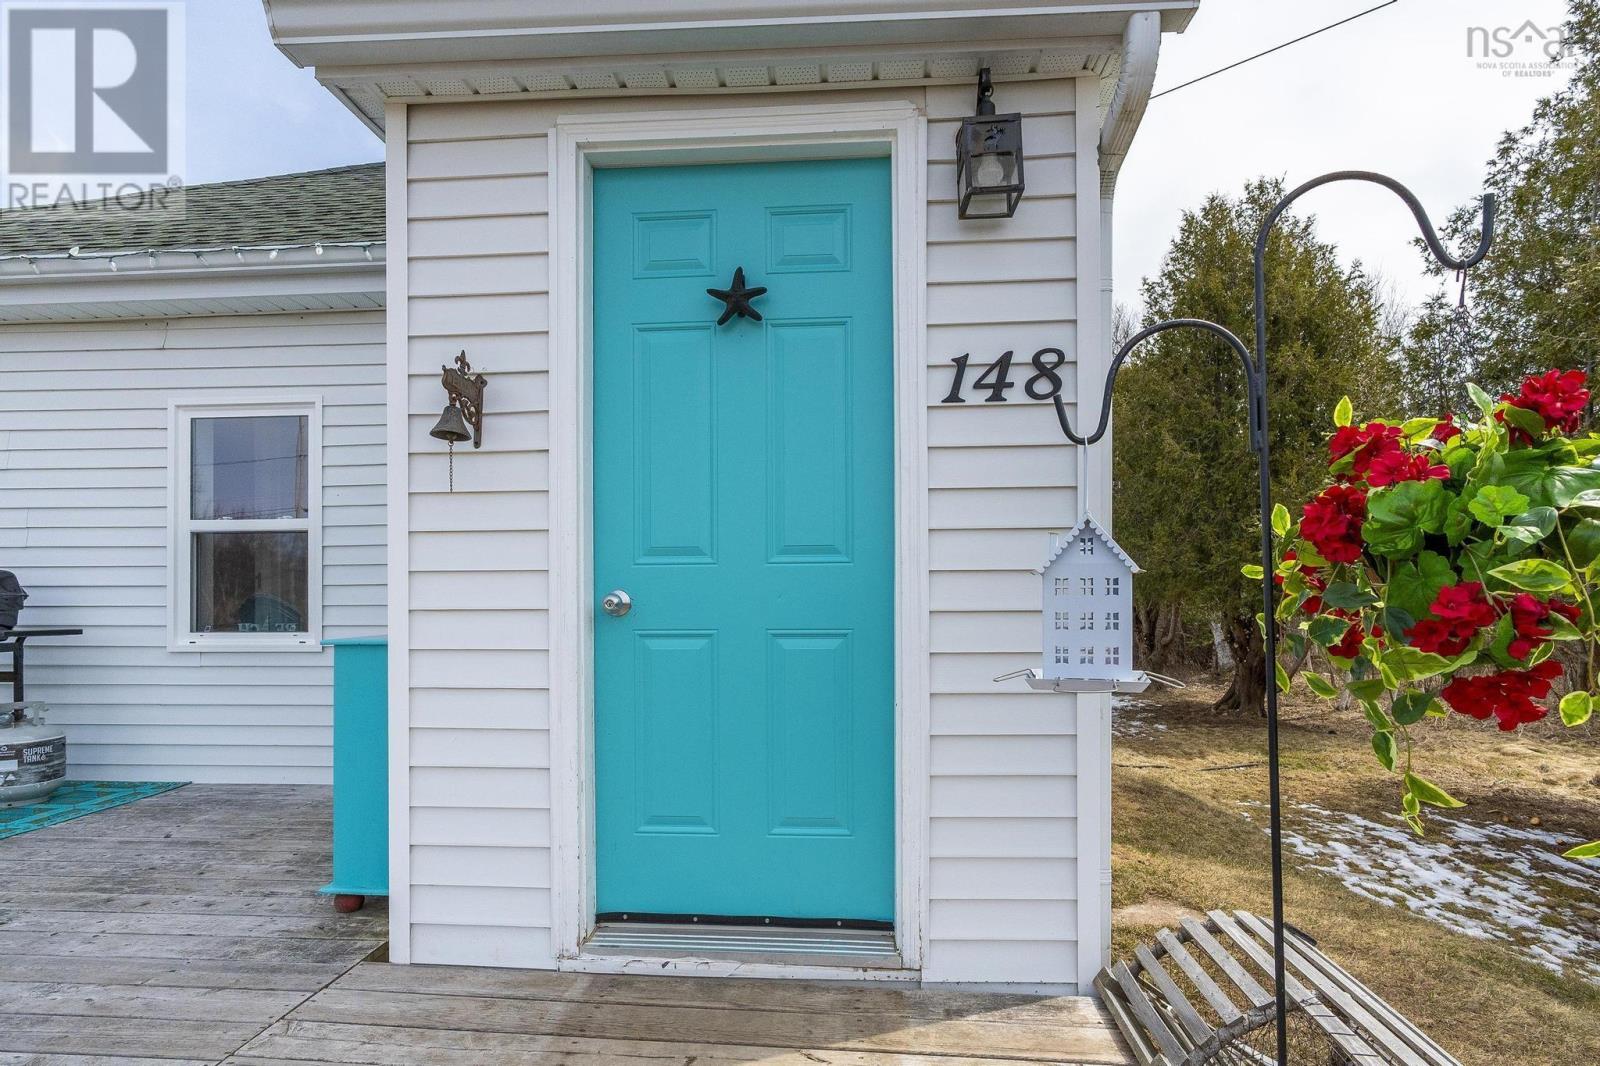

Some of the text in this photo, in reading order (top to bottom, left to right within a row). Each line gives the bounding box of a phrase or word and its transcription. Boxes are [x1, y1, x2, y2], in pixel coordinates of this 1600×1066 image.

[941, 347, 1066, 404] 148
[23, 745, 54, 756] SUPREME
[23, 754, 42, 763] TANK
